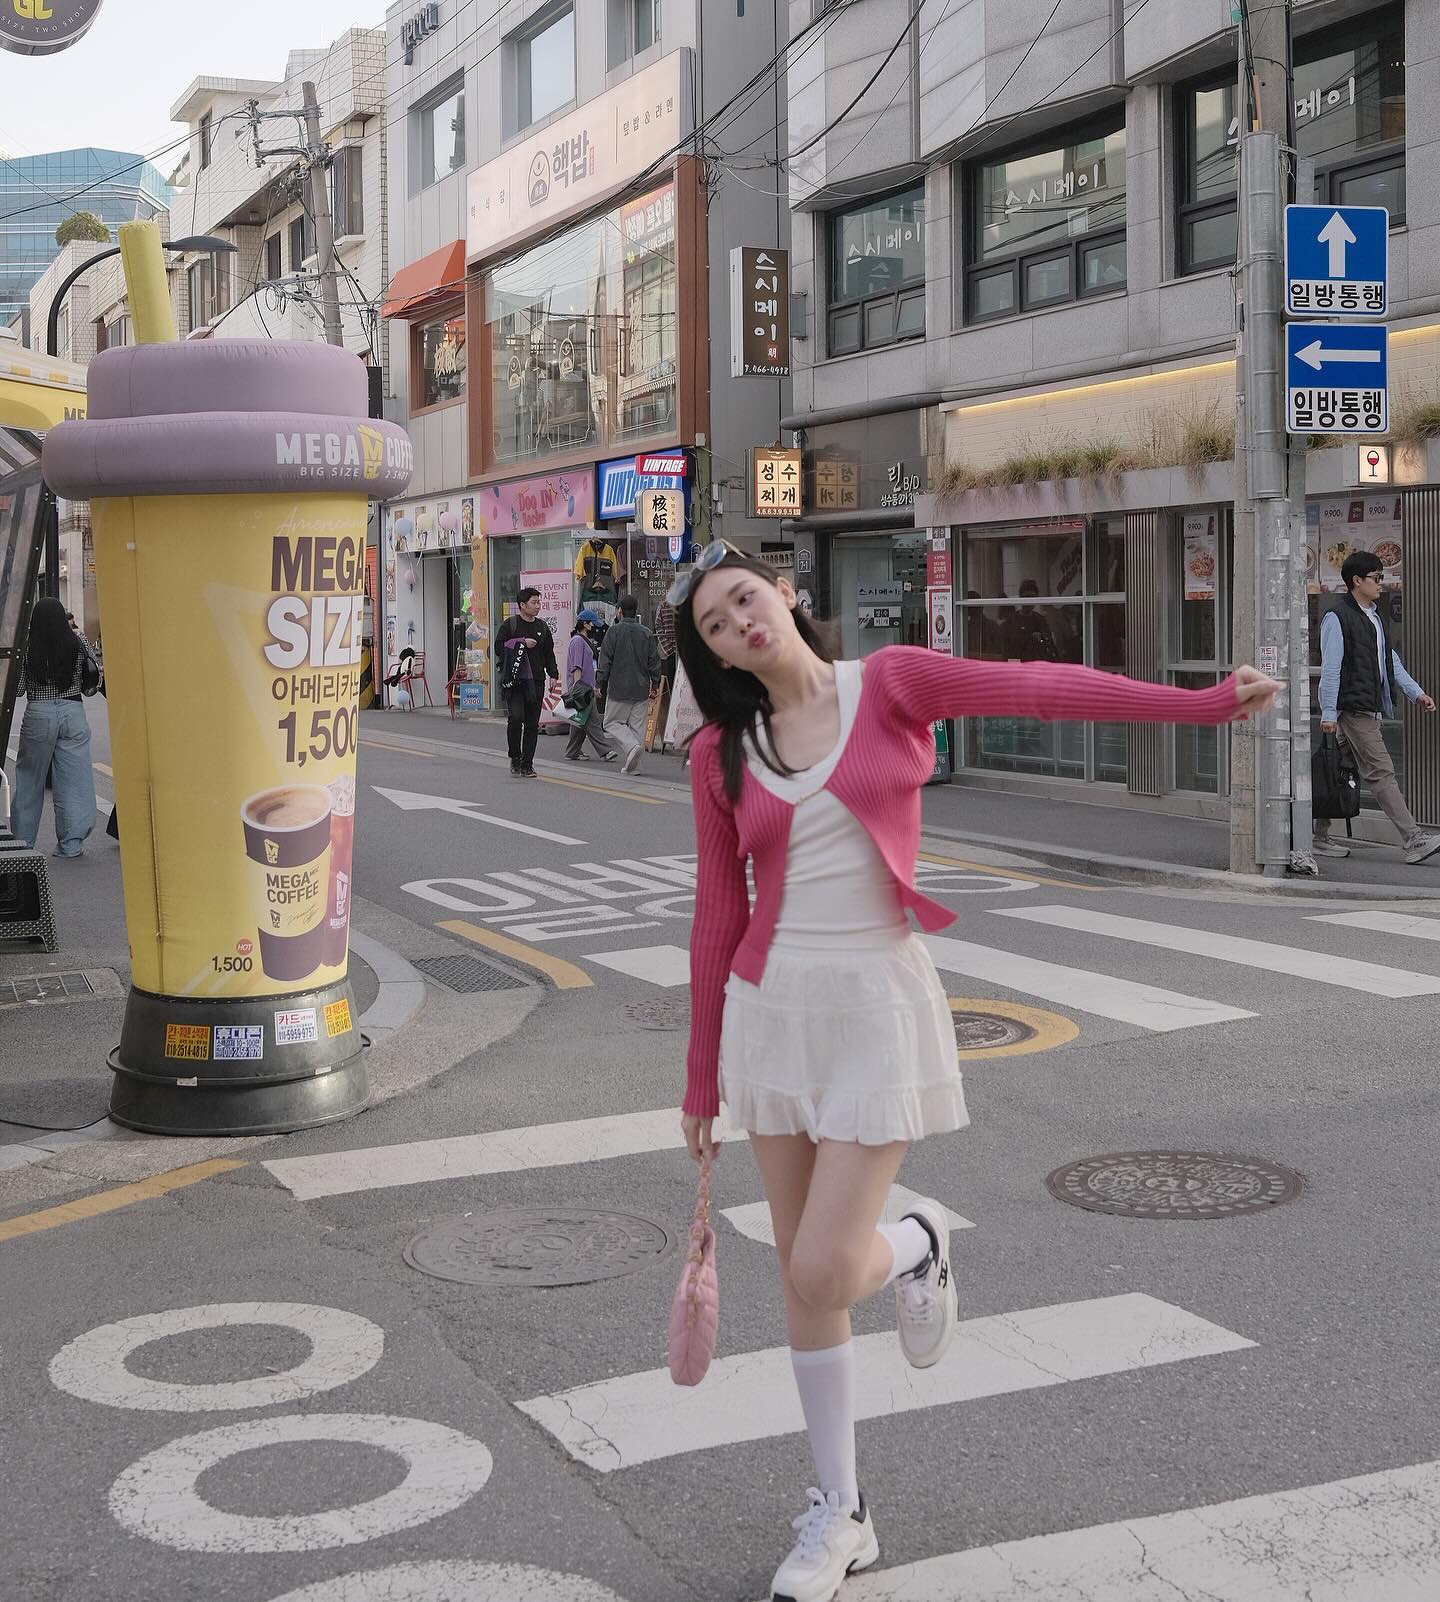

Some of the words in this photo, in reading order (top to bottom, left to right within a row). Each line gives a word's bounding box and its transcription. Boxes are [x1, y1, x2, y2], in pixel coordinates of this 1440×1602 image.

[62, 6, 85, 27] SHOT
[552, 129, 590, 189] 핵밥
[848, 221, 921, 265] 스시메이
[754, 252, 778, 341] 스시메이
[1290, 283, 1384, 310] 일방통행
[1294, 391, 1383, 428] 일방통행
[275, 432, 360, 466] MEGA
[300, 467, 325, 477] BIG
[331, 467, 360, 477] SIZE
[642, 458, 686, 473] VINTAGE
[761, 462, 797, 481] 성수
[760, 487, 797, 505] 찌개
[544, 583, 569, 591] EVENT
[278, 707, 358, 767] 1,500
[266, 871, 310, 889] MEGA
[267, 879, 319, 904] COFFEE
[237, 943, 252, 951] HOT
[211, 955, 253, 973] 1,500
